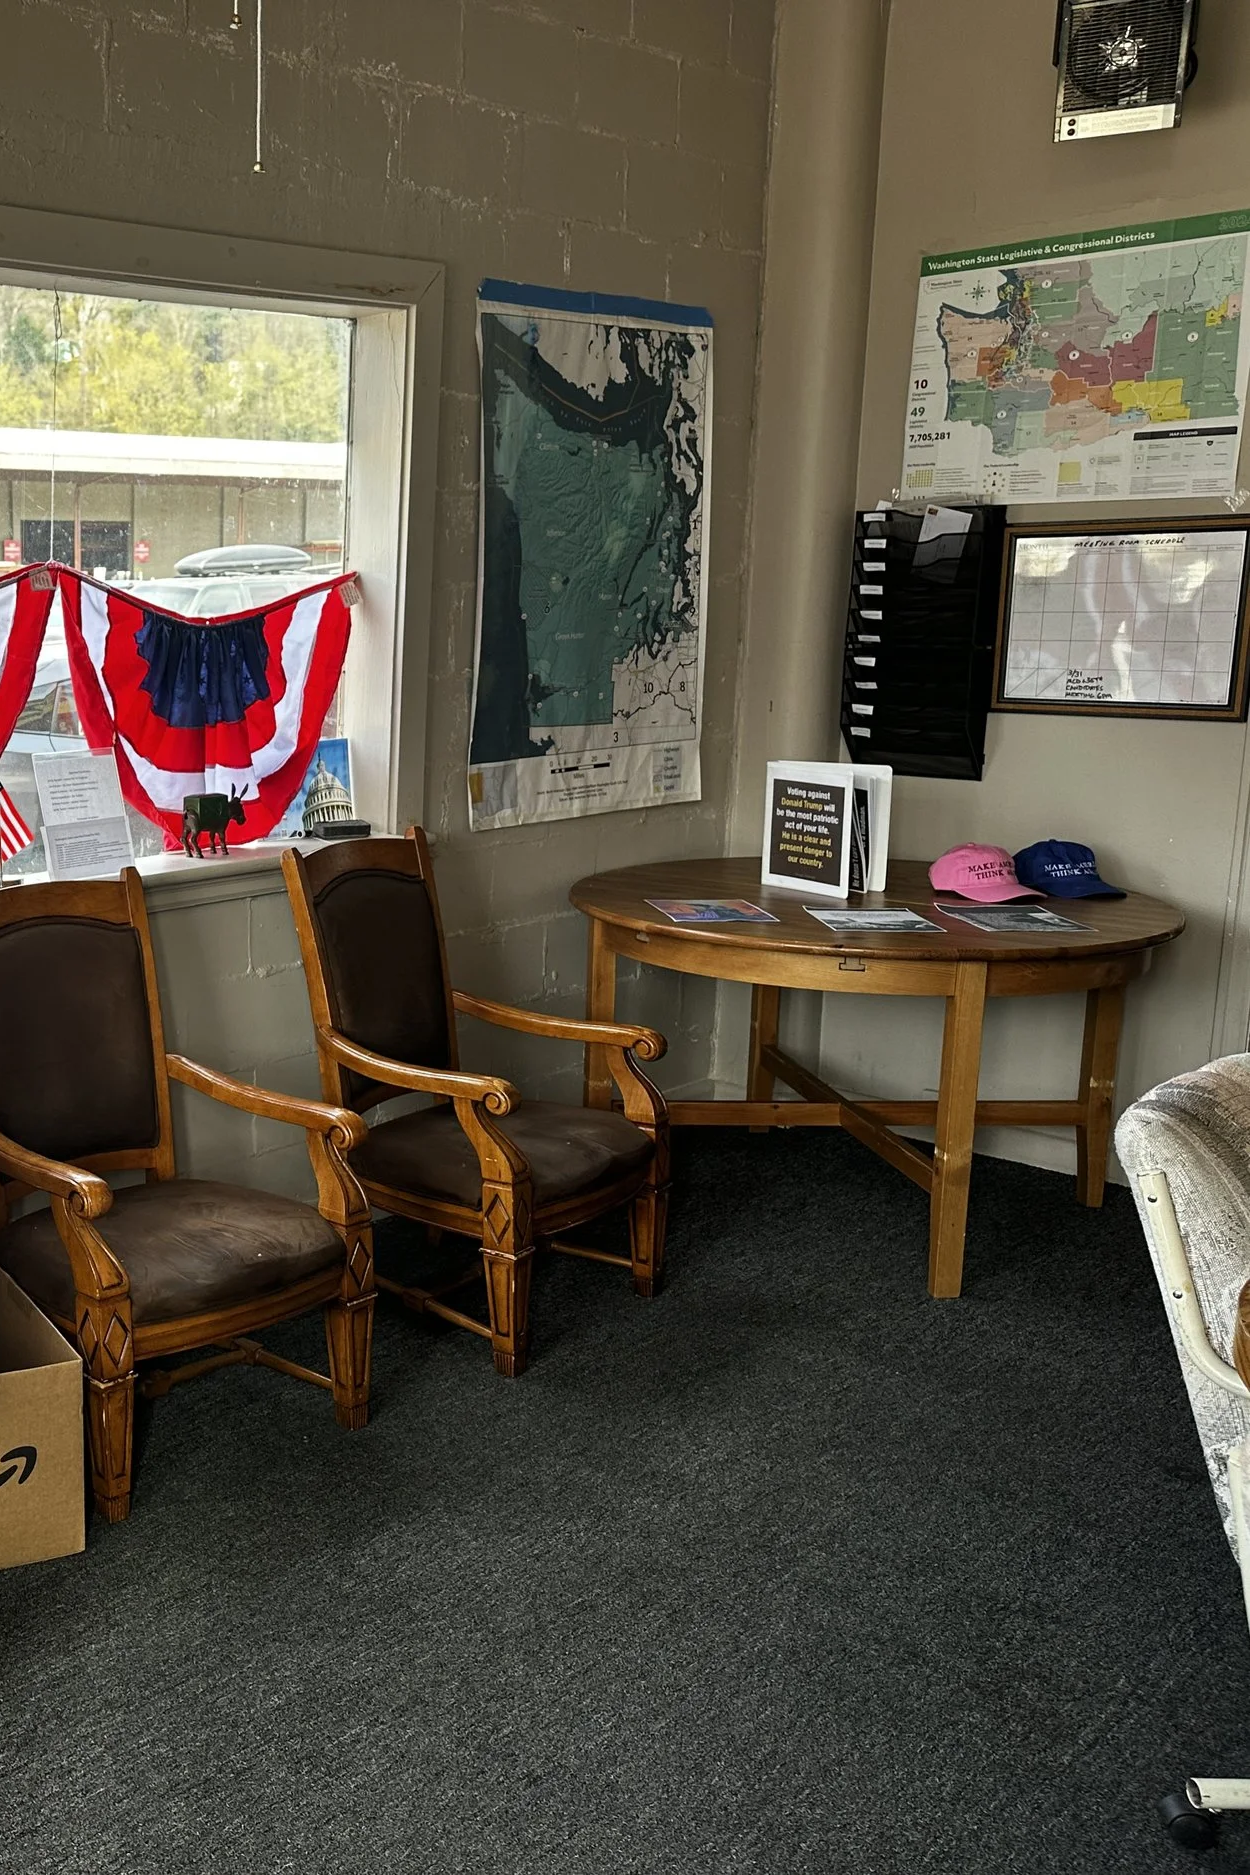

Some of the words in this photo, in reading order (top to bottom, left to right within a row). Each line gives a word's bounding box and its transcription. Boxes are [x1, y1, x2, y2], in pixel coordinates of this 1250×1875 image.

[929, 259, 976, 270] Washington
[977, 254, 999, 264] State
[1000, 247, 1043, 261] Legislative
[1053, 236, 1113, 253] Congressional
[1115, 231, 1155, 244] Districts
[914, 379, 928, 389] 10
[910, 407, 925, 417] 49
[909, 432, 950, 443] 7,705,281
[1144, 537, 1186, 545] SCHEDULE
[545, 601, 550, 614] 6
[689, 607, 695, 617] 9
[1068, 669, 1082, 678] 3/31
[643, 682, 654, 693] 10
[680, 682, 685, 691] 8
[613, 732, 618, 742] 3
[787, 786, 806, 798] Voting
[808, 790, 830, 800] against
[781, 797, 803, 808] Donald
[804, 800, 823, 812] Trump
[824, 804, 835, 812] will
[776, 808, 784, 816] be
[786, 808, 795, 818] the
[797, 811, 812, 820] most
[813, 813, 839, 824] patriotic
[785, 821, 795, 829] act
[796, 821, 802, 830] of
[803, 824, 817, 832] your
[818, 825, 829, 834] life.
[782, 831, 790, 839] He
[791, 832, 795, 840] is
[803, 834, 818, 843] clear
[820, 837, 831, 846] and
[780, 843, 802, 853] present
[804, 846, 825, 856] danger
[826, 849, 832, 858] to
[788, 855, 798, 863] our
[799, 857, 823, 869] country.
[968, 862, 995, 872] MAKE
[976, 870, 1004, 880] THINK
[1051, 869, 1082, 878] THINK
